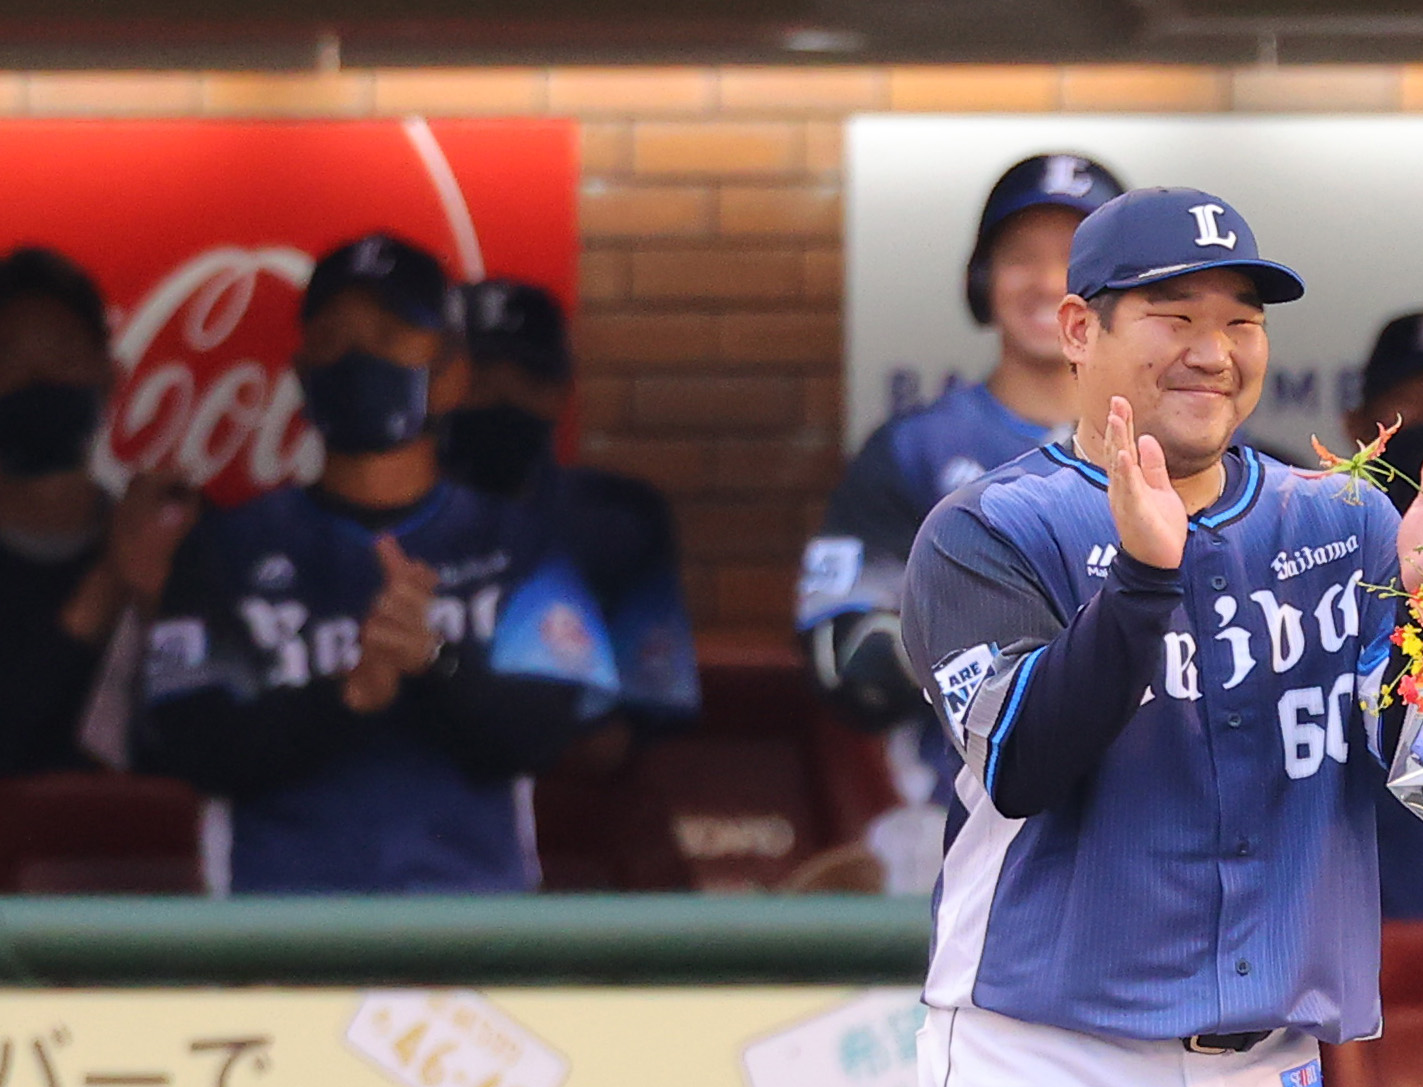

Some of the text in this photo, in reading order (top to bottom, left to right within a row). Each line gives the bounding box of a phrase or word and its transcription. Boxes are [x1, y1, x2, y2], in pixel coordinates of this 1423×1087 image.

[1045, 155, 1094, 198] L
[1188, 203, 1238, 250] L
[1140, 569, 1364, 706] eibu
[948, 660, 982, 688] ARE
